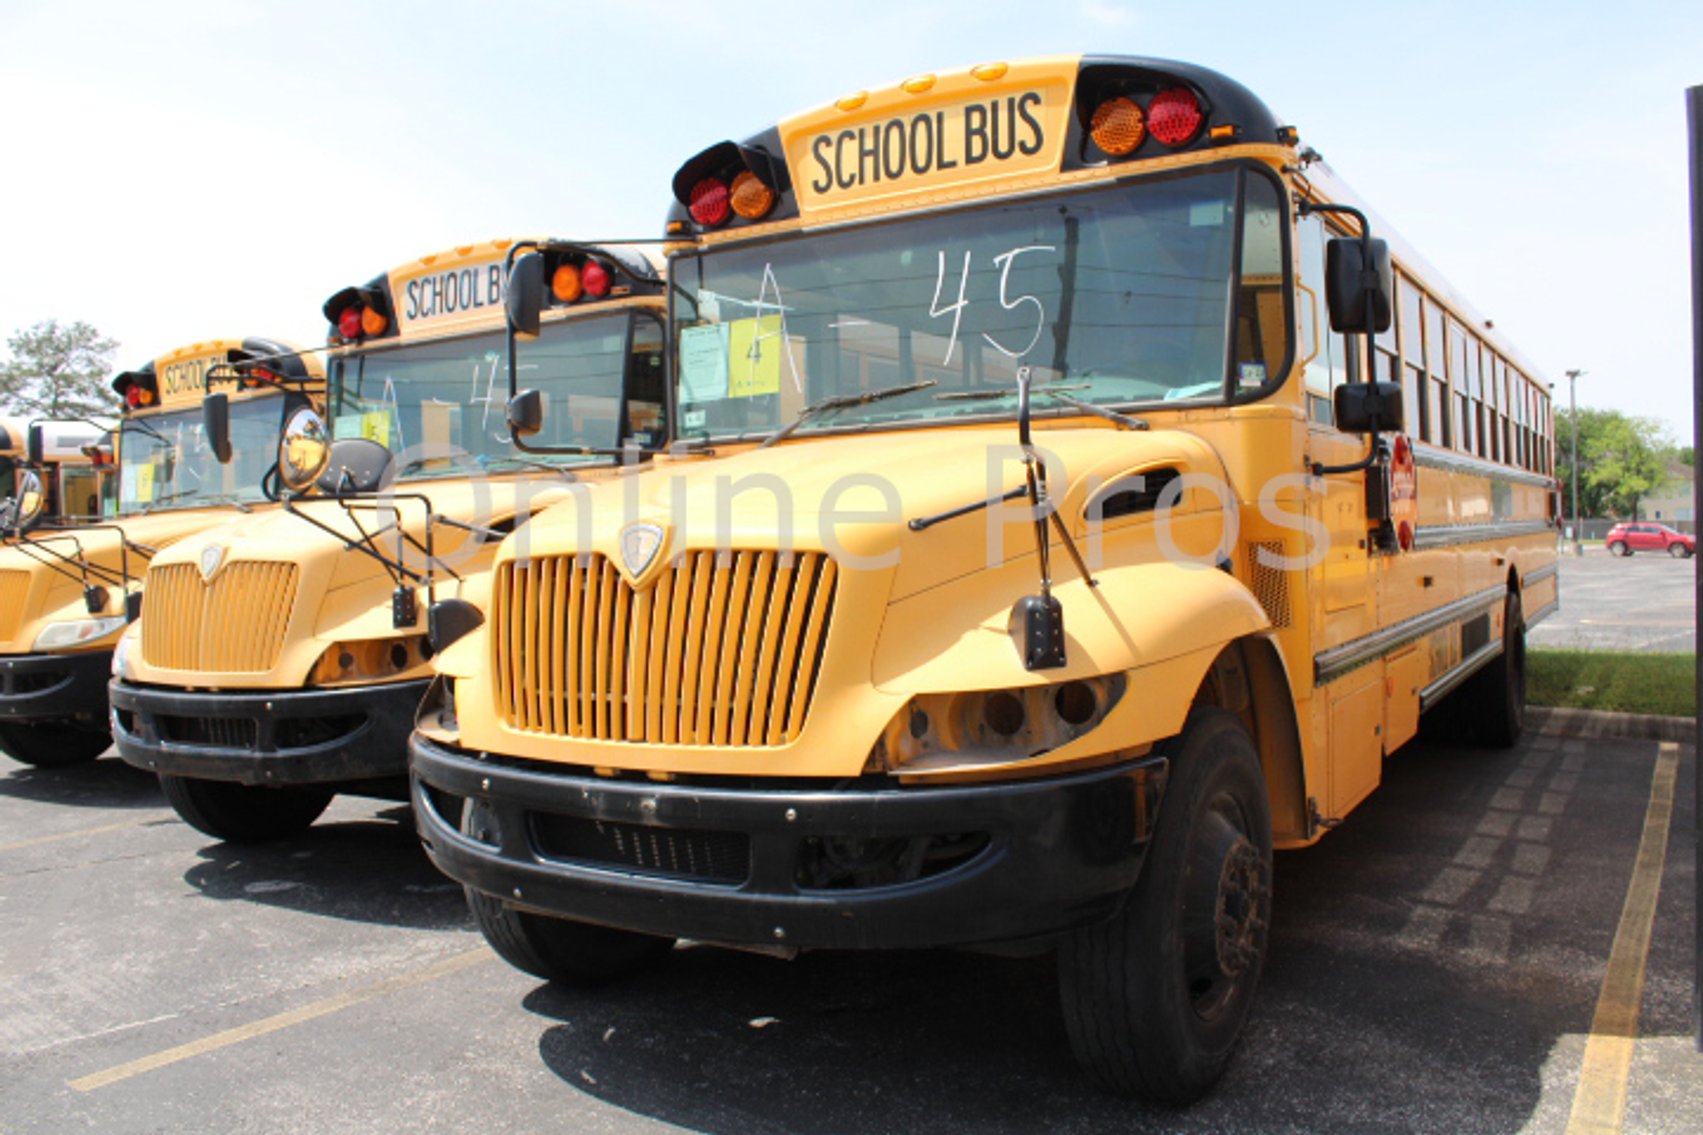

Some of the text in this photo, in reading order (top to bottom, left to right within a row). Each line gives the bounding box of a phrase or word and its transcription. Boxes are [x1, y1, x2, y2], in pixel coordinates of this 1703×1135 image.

[812, 92, 1044, 194] SCHOOL BUS
[406, 267, 485, 320] SCHOOL
[165, 359, 206, 396] SCHOOL
